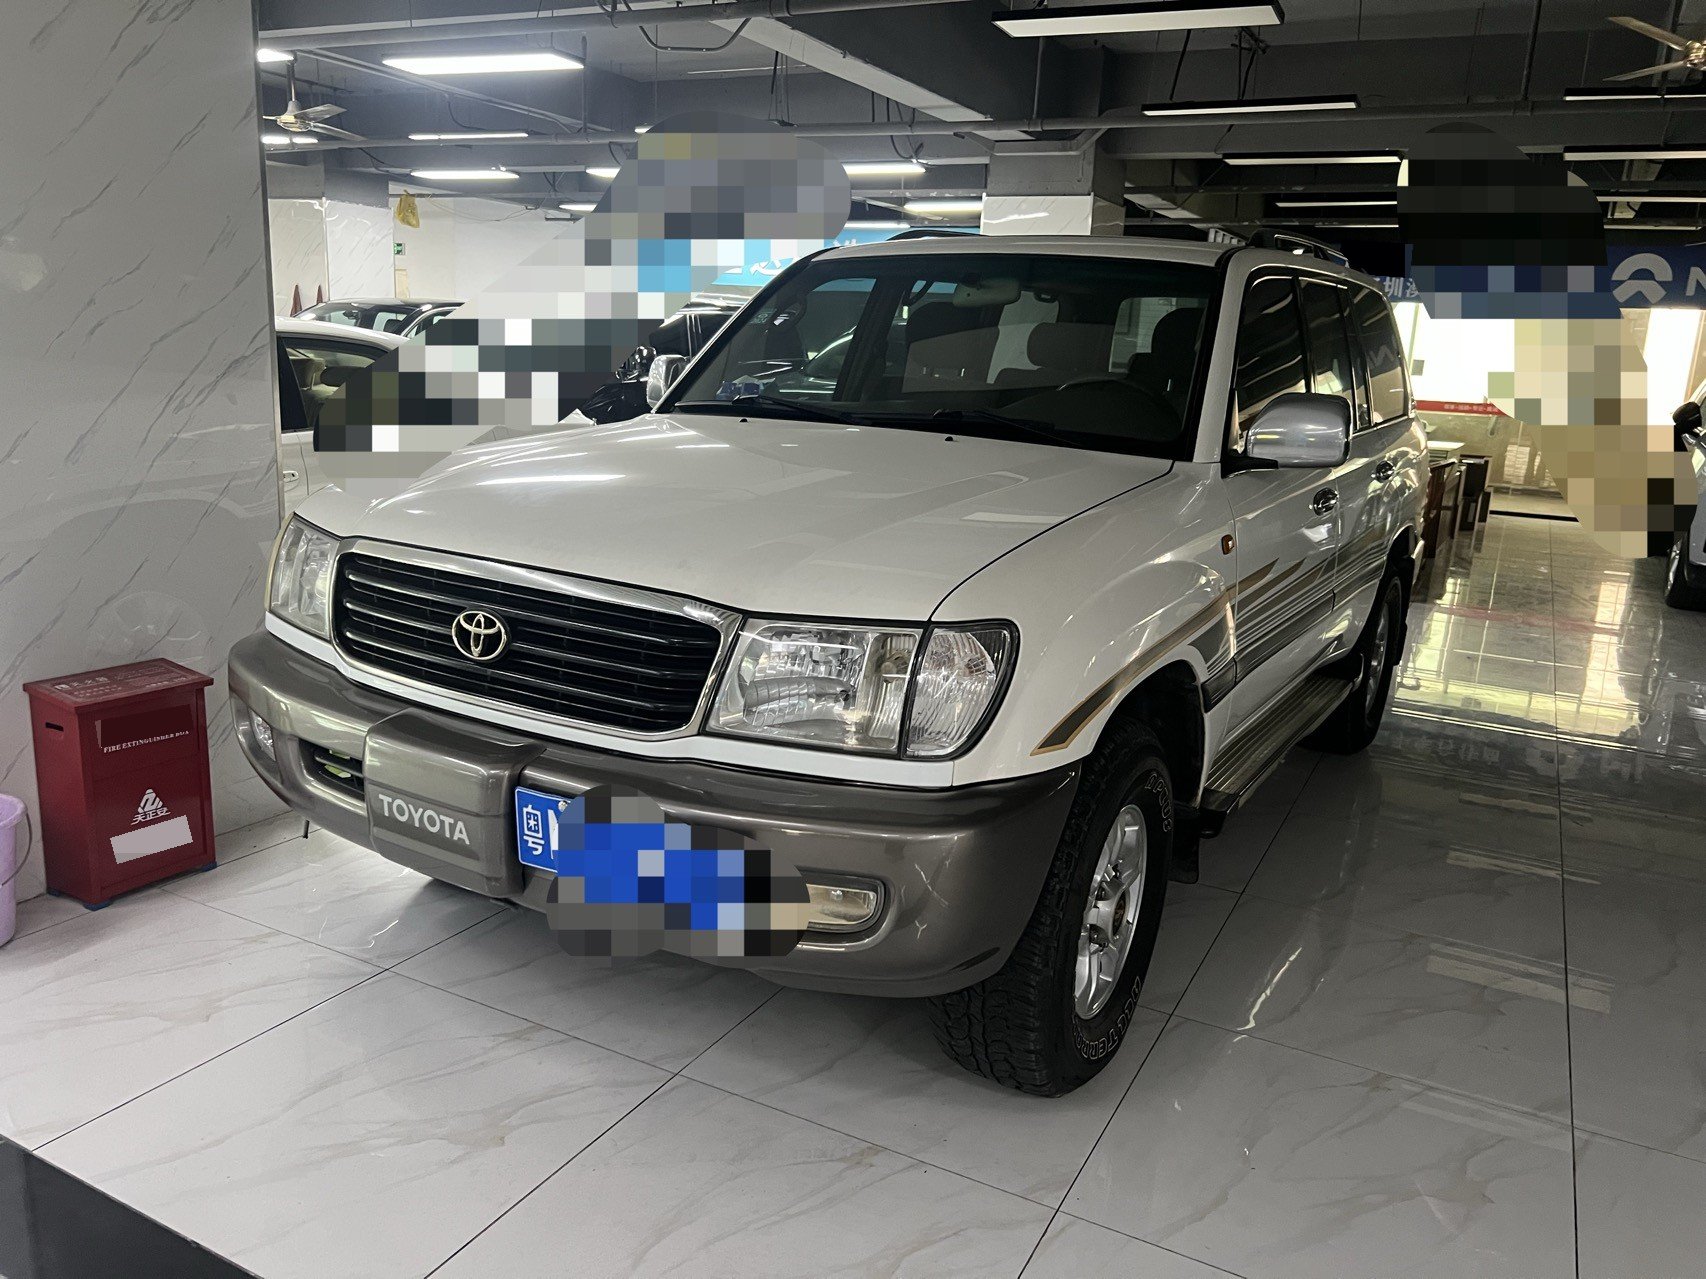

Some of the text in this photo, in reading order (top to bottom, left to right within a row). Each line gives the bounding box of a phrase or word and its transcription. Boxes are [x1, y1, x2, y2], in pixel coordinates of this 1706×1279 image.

[103, 744, 121, 753] FIRE
[378, 793, 471, 846] TOYOTA
[522, 804, 559, 860] 粤
